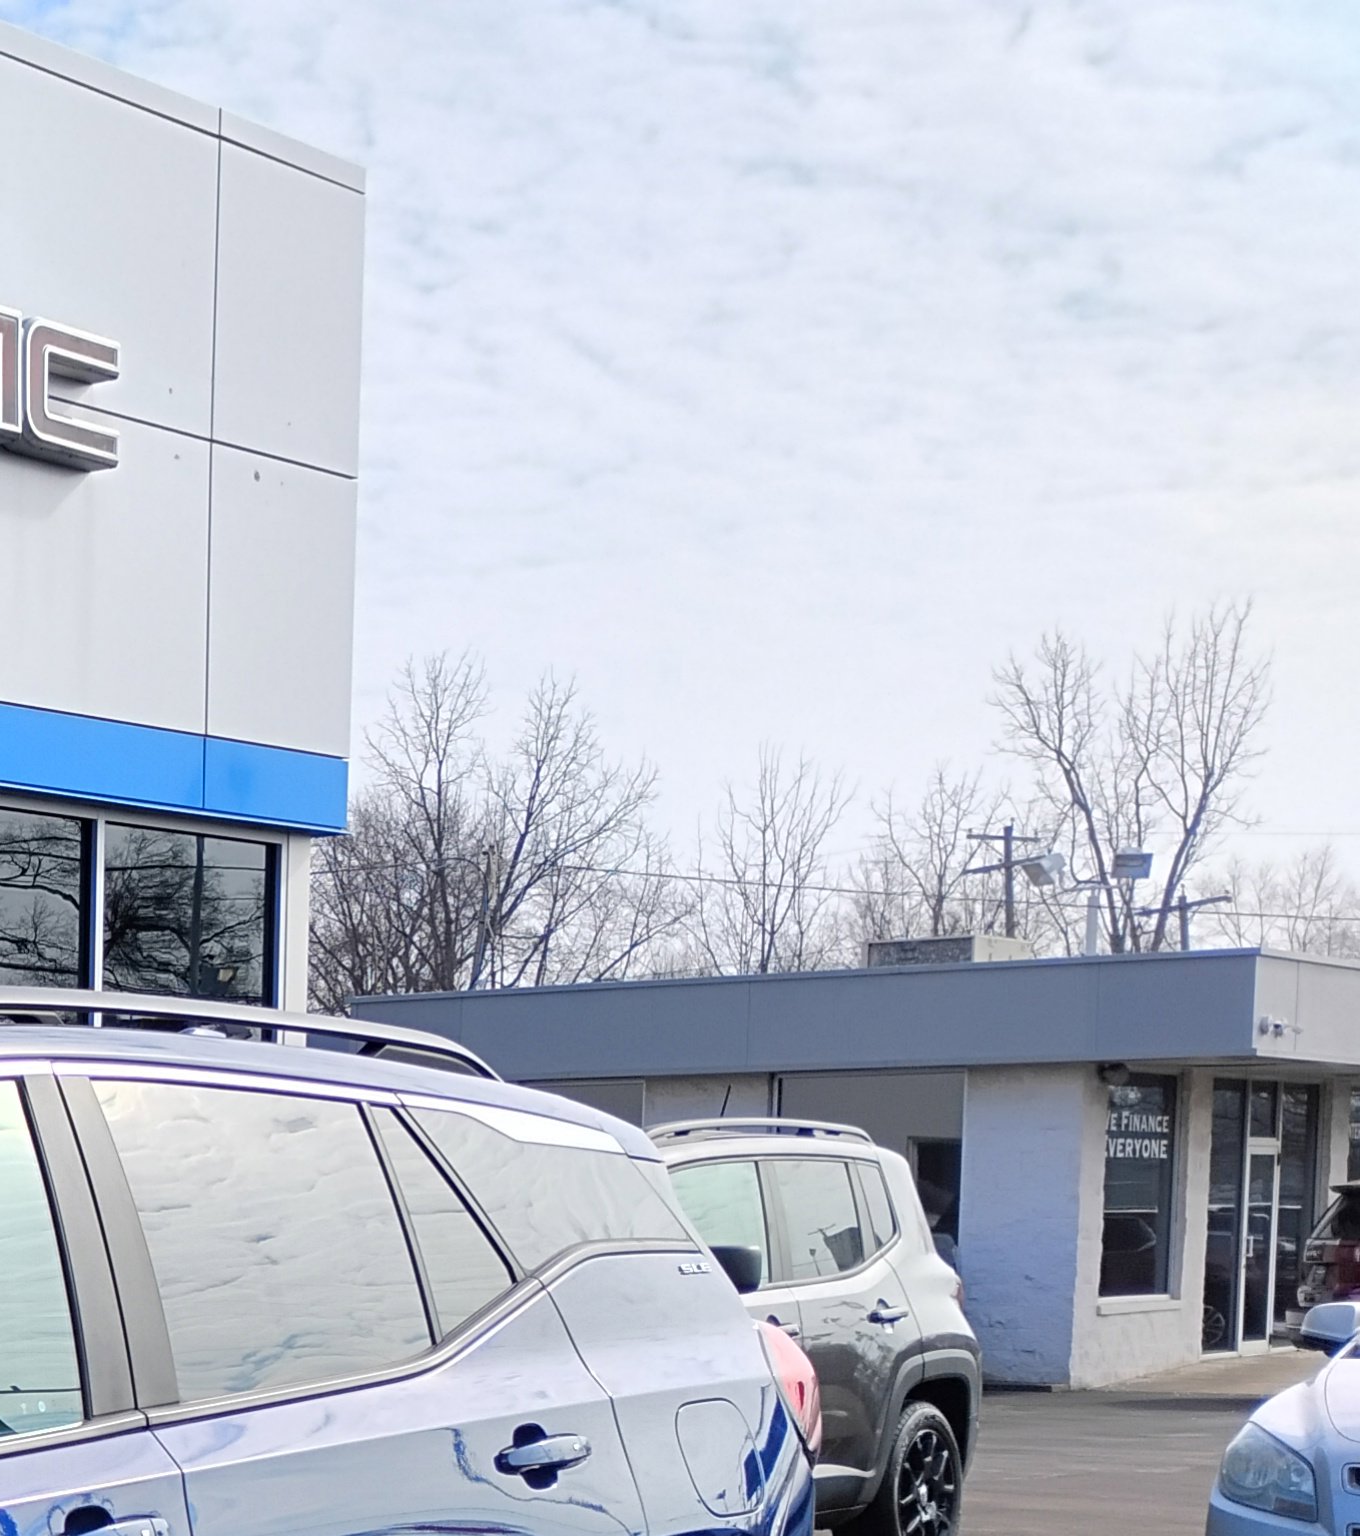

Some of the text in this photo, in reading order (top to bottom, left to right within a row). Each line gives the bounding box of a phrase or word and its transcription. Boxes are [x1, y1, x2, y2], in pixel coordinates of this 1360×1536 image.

[1121, 1110, 1169, 1132] FINANCE
[1105, 1135, 1169, 1158] VERYONE
[679, 1263, 712, 1276] SLE
